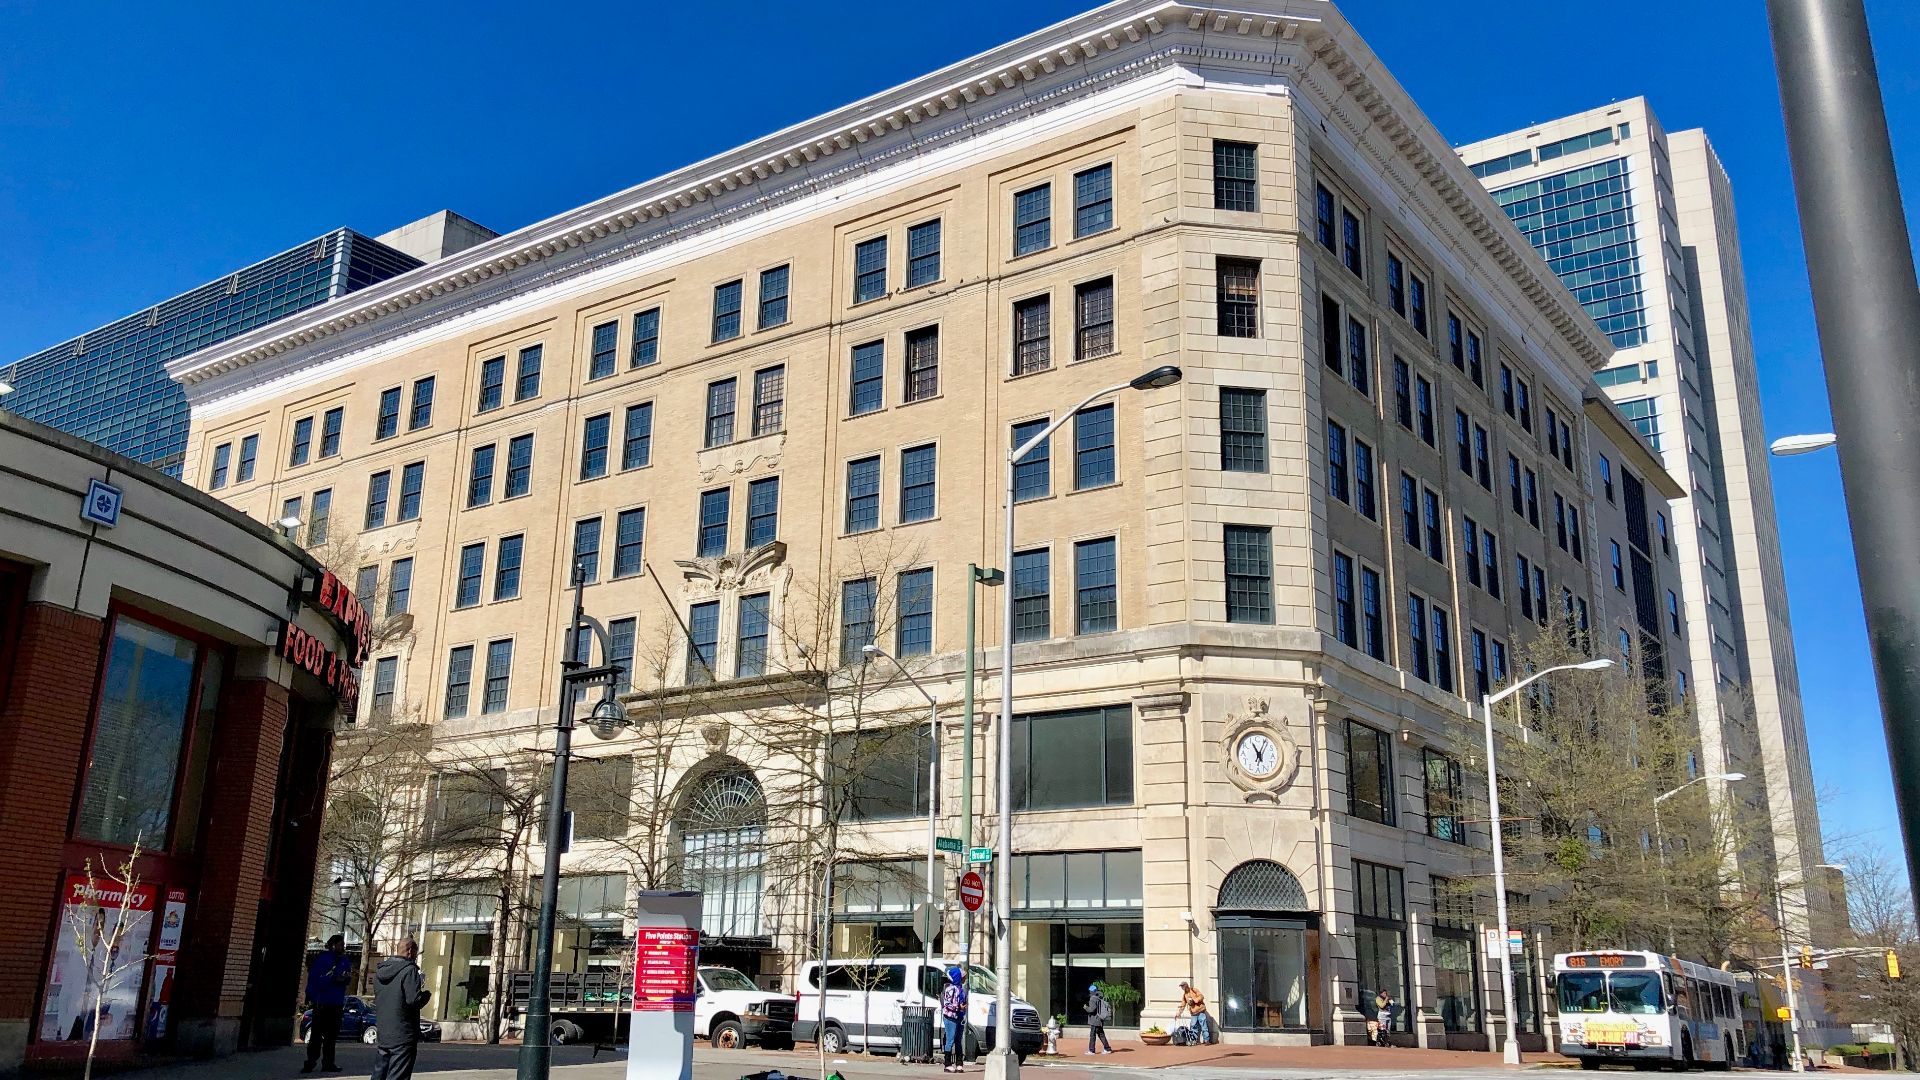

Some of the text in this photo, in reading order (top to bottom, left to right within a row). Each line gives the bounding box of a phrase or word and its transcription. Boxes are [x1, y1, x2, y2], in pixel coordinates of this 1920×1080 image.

[284, 622, 325, 677] FOOD
[327, 650, 337, 687] &
[937, 838, 956, 850] Alabama
[971, 850, 985, 860] Broad
[168, 891, 184, 900] LOTTO
[964, 895, 979, 905] ENTER
[645, 931, 692, 941] Five Points Station
[1569, 956, 1625, 967] 816 EMORY
